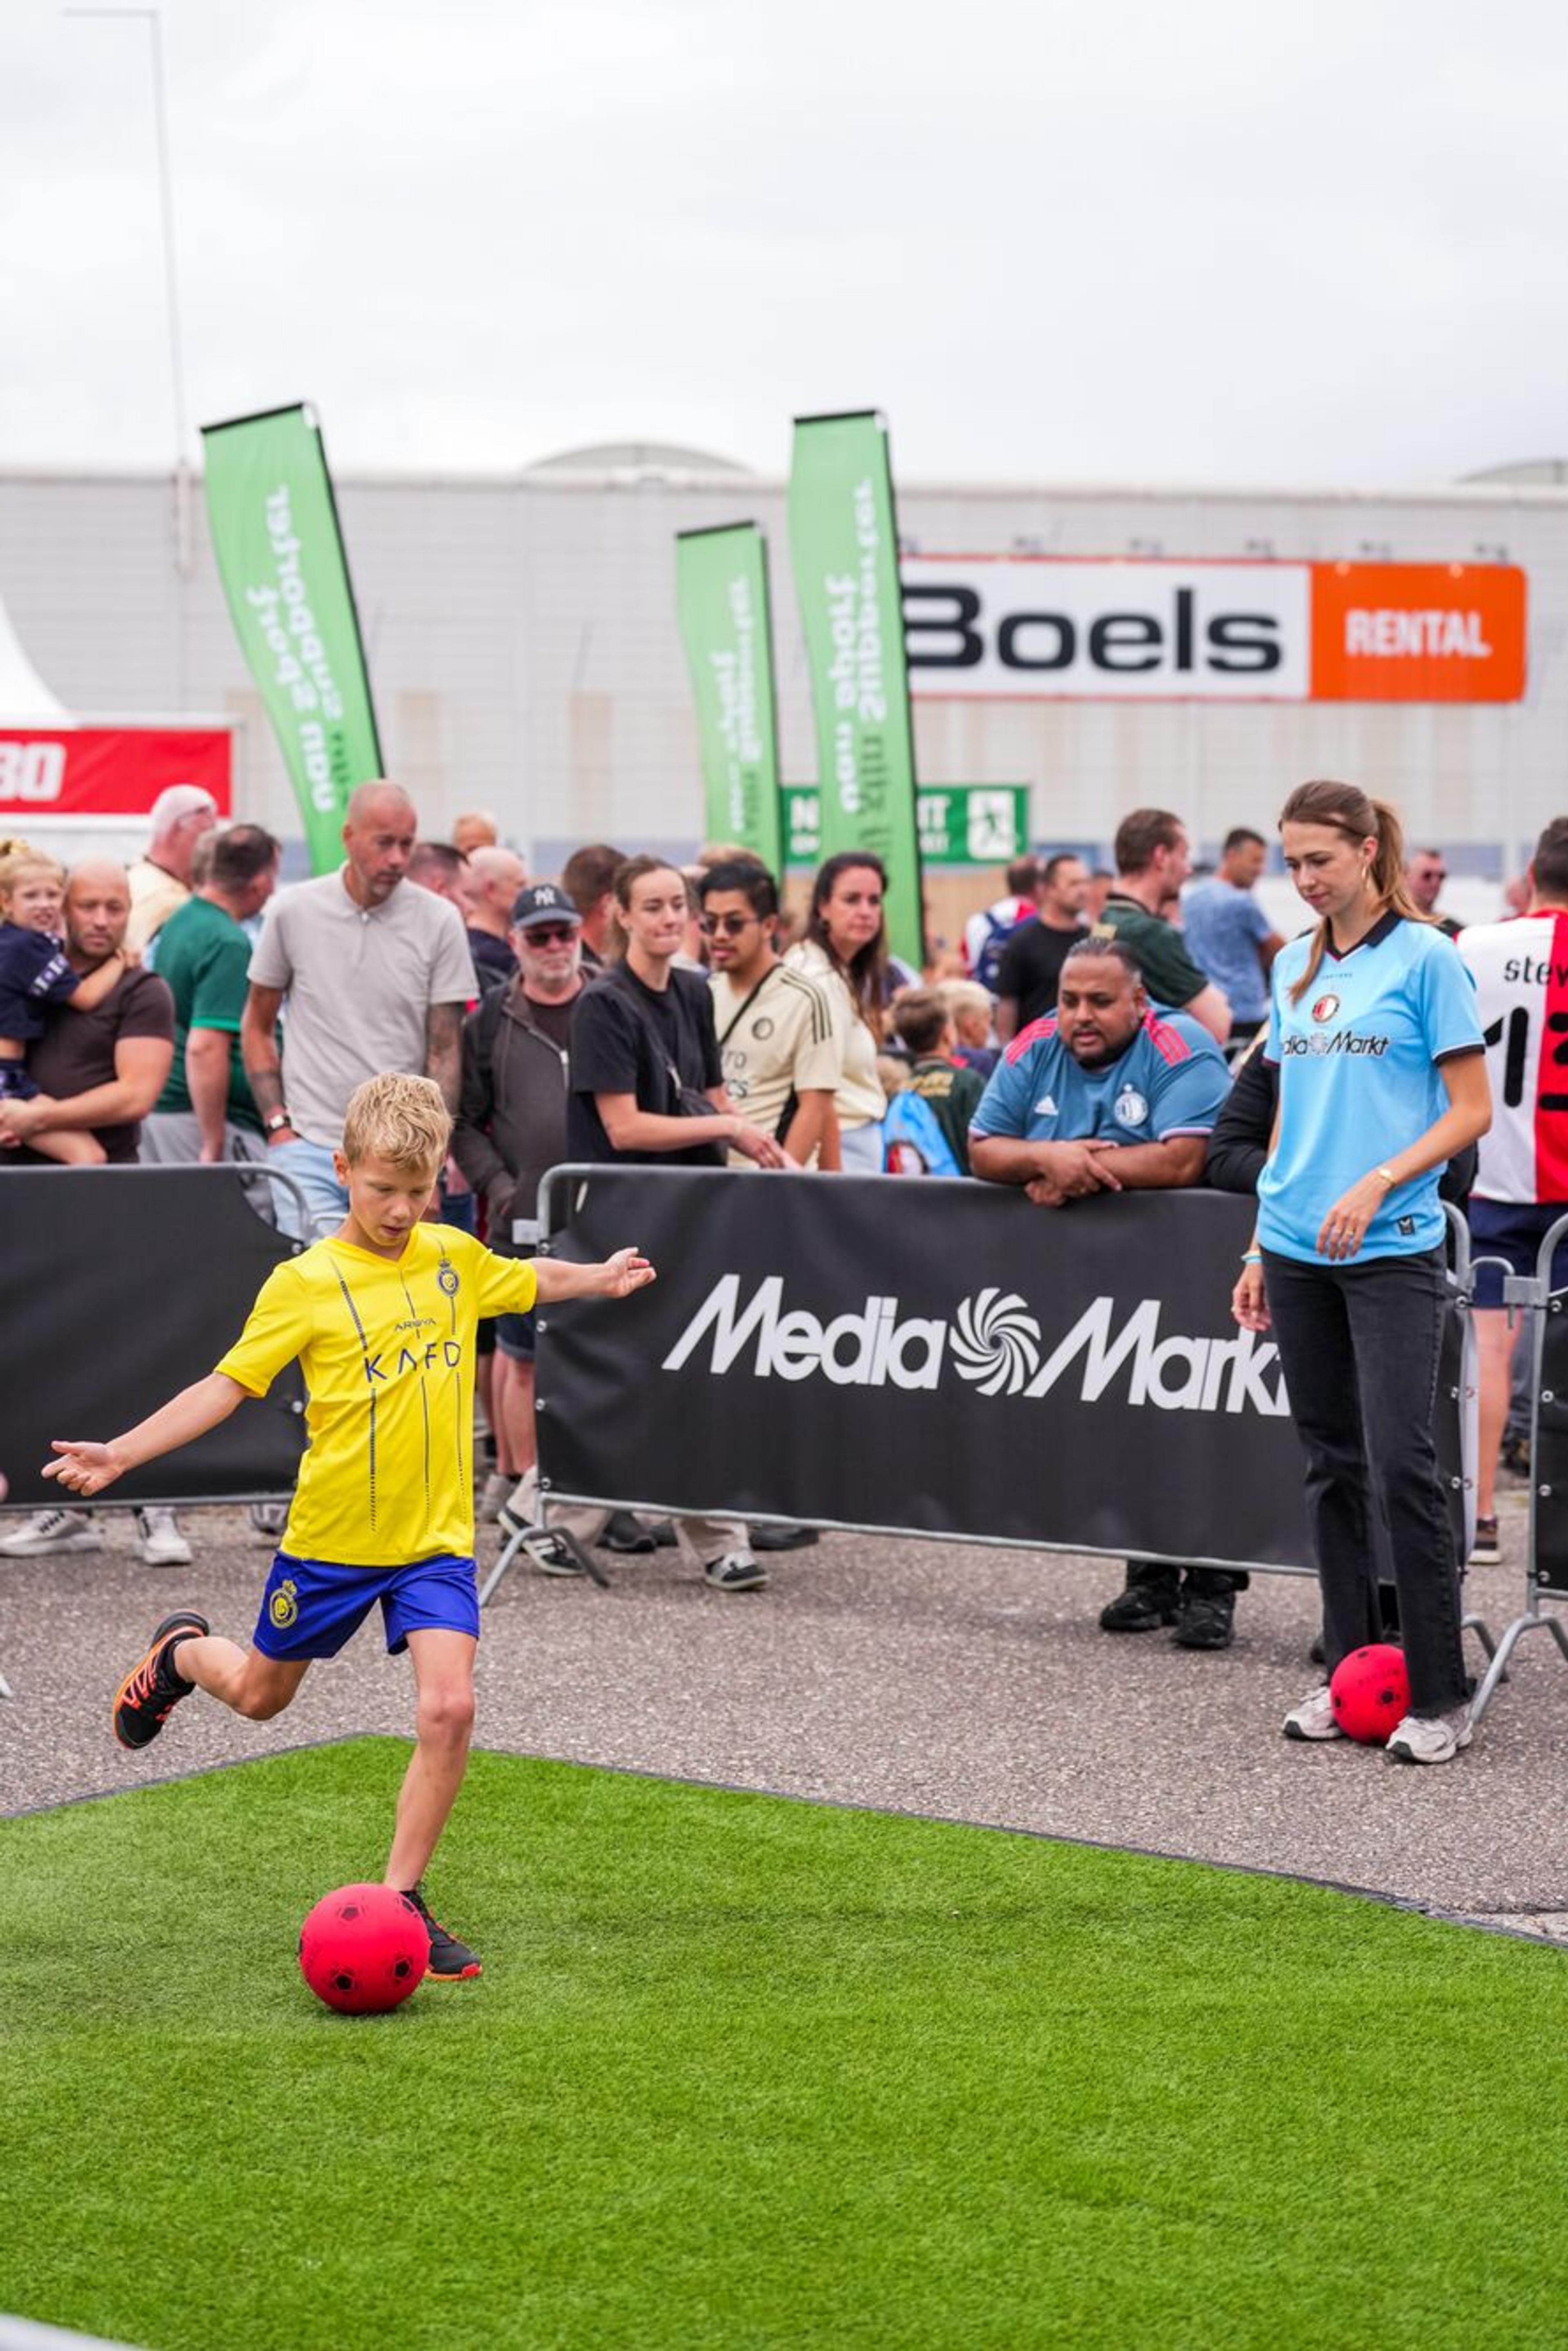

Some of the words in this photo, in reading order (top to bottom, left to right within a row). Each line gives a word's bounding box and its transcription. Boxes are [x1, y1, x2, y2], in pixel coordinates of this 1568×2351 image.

[902, 586, 1281, 674] Boels
[1346, 608, 1493, 658] RENTAL
[1326, 1030, 1388, 1055] Markt
[661, 1273, 947, 1390] Media
